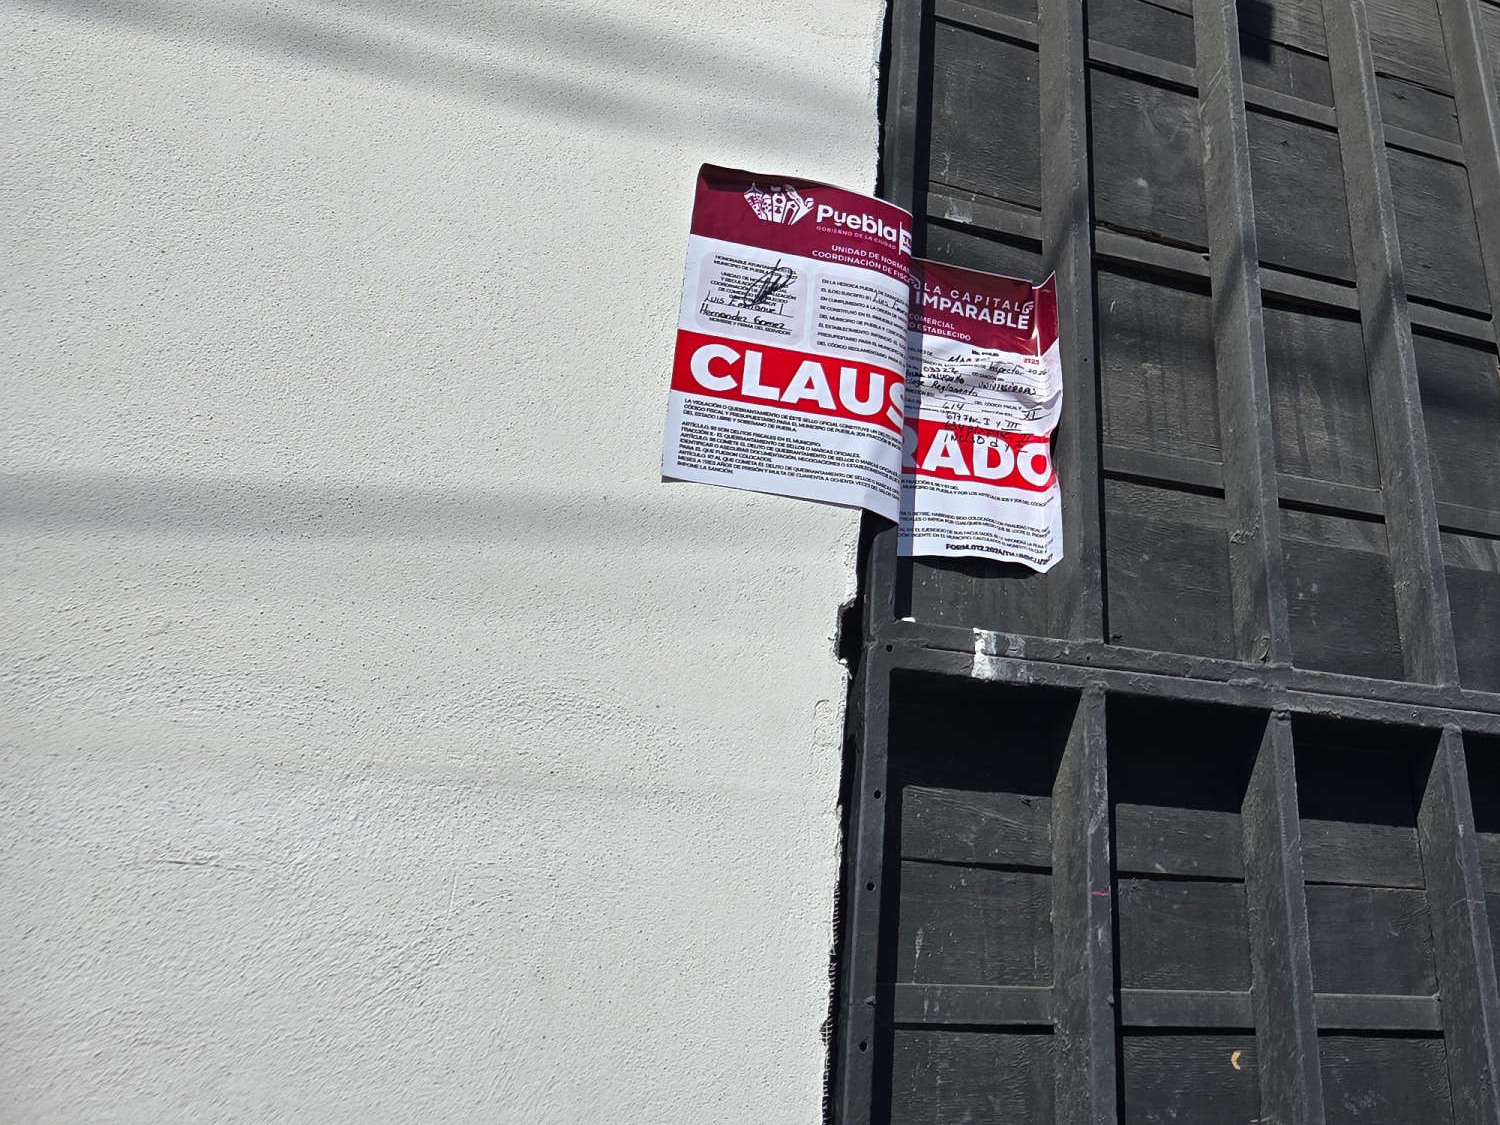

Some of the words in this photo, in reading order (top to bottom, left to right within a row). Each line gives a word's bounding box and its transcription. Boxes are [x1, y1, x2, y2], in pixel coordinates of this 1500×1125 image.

[816, 204, 897, 242] Puebla
[816, 226, 852, 236] GOBIERNO
[812, 250, 881, 269] COORDINACIÓN
[882, 265, 892, 274] DE
[831, 245, 867, 256] UNIDAD
[868, 252, 880, 260] DE
[924, 283, 942, 295] LA
[950, 290, 1021, 312] CAPITAL
[909, 313, 955, 329] COMERCIAL
[915, 292, 1030, 330] IMPARABLE
[918, 323, 971, 341] ESTABLECIDO
